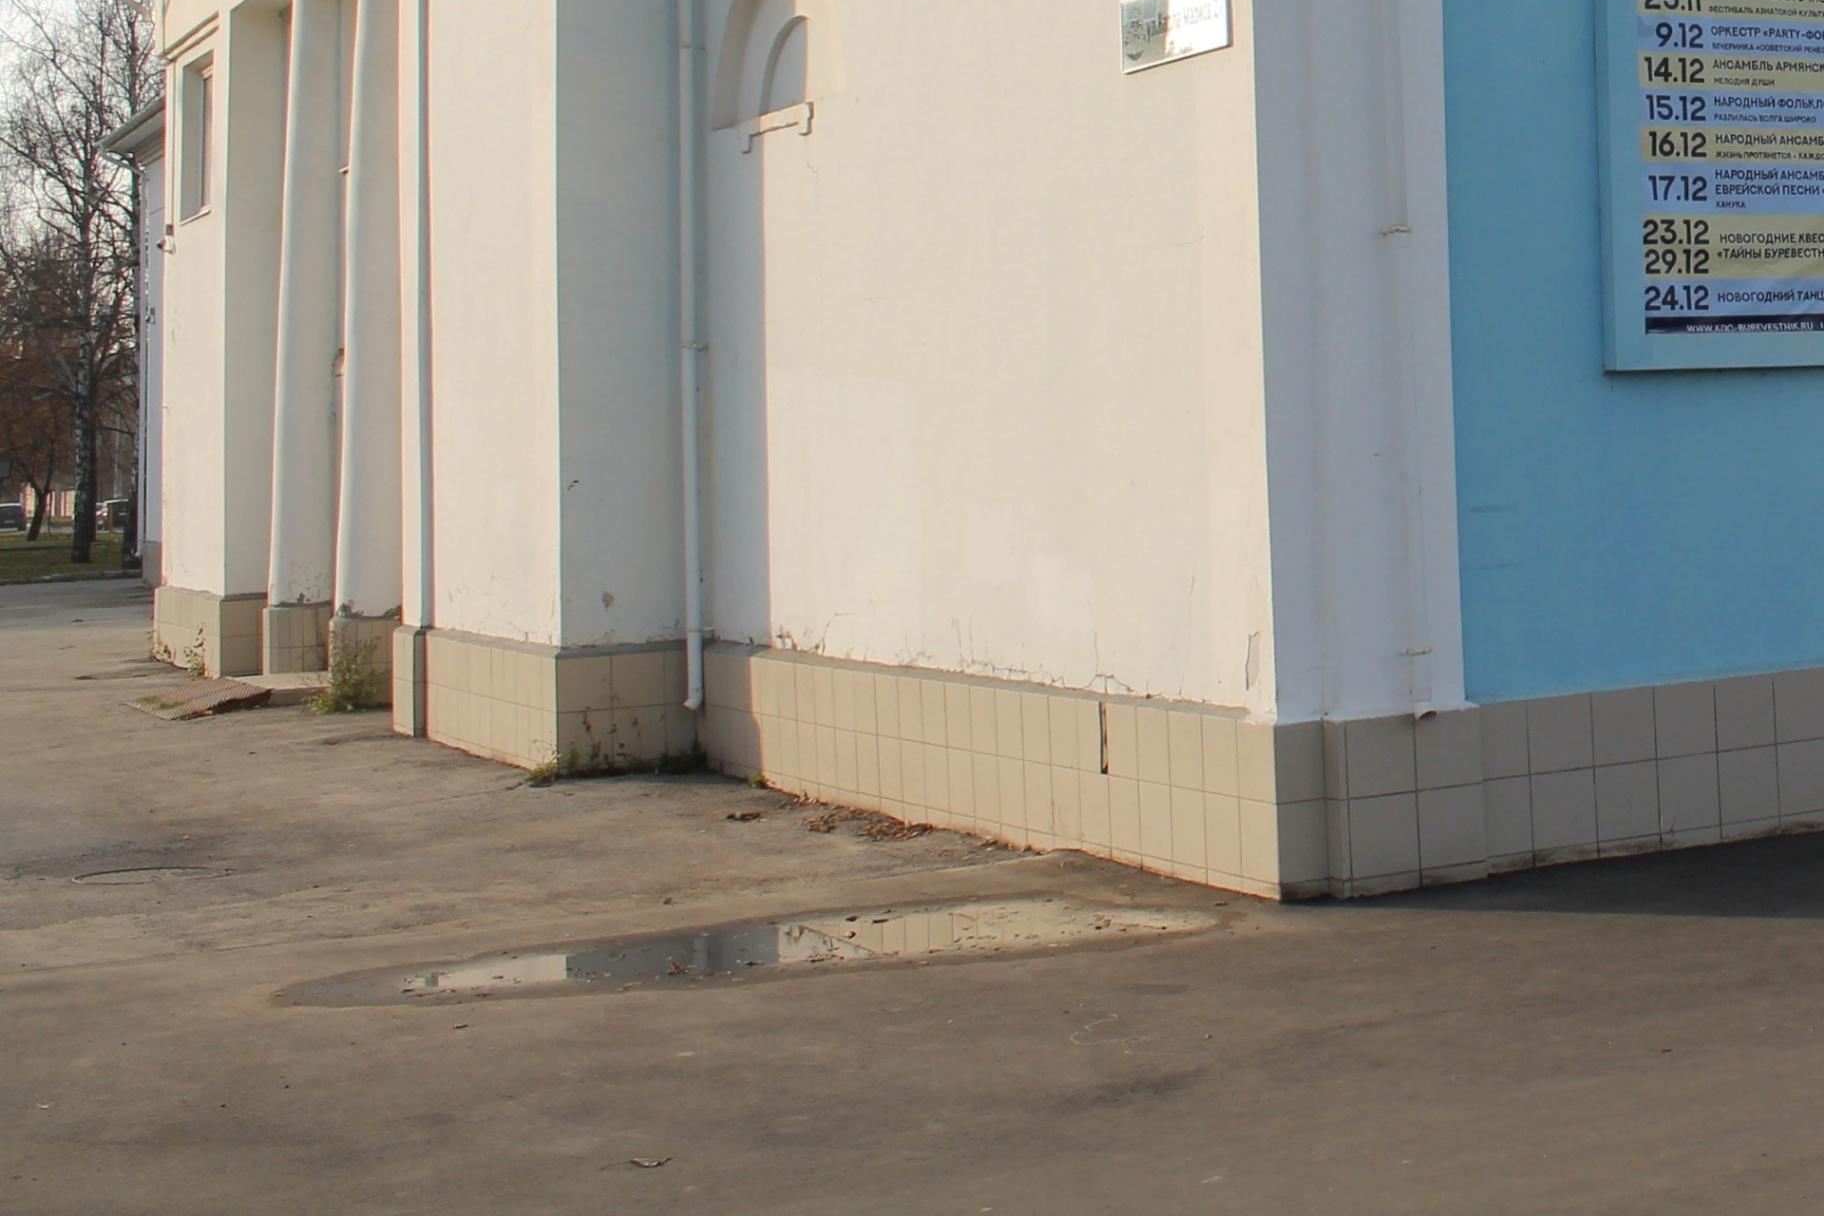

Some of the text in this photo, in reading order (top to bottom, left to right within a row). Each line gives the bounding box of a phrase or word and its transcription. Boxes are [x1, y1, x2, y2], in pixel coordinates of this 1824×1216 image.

[1656, 22, 1703, 48] 9.12
[1711, 26, 1760, 37] ОРКЕСТР
[1644, 56, 1705, 83] 14.12
[1713, 59, 1773, 71] АНСАМБЛЬ
[1646, 94, 1706, 121] 15.12
[1714, 96, 1775, 109] НАРОДНЫЙ
[1648, 131, 1707, 158] 16.12
[1715, 133, 1776, 145] НАРОДНЫЙ
[1715, 168, 1777, 181] НАРОДНЫЙ
[1648, 175, 1708, 201] 17.12
[1715, 183, 1780, 195] ЕВРЕЙСКОЙ
[1782, 184, 1819, 195] ПЕСНИ
[1643, 219, 1709, 244] 23.12
[1720, 233, 1796, 244] НОВОГОДНИЕ
[1717, 247, 1762, 259] «ТАЙНЫ
[1645, 249, 1709, 274] 29.12
[1644, 285, 1709, 311] 24.12
[1718, 290, 1794, 303] НОВОГОДНИЙ
